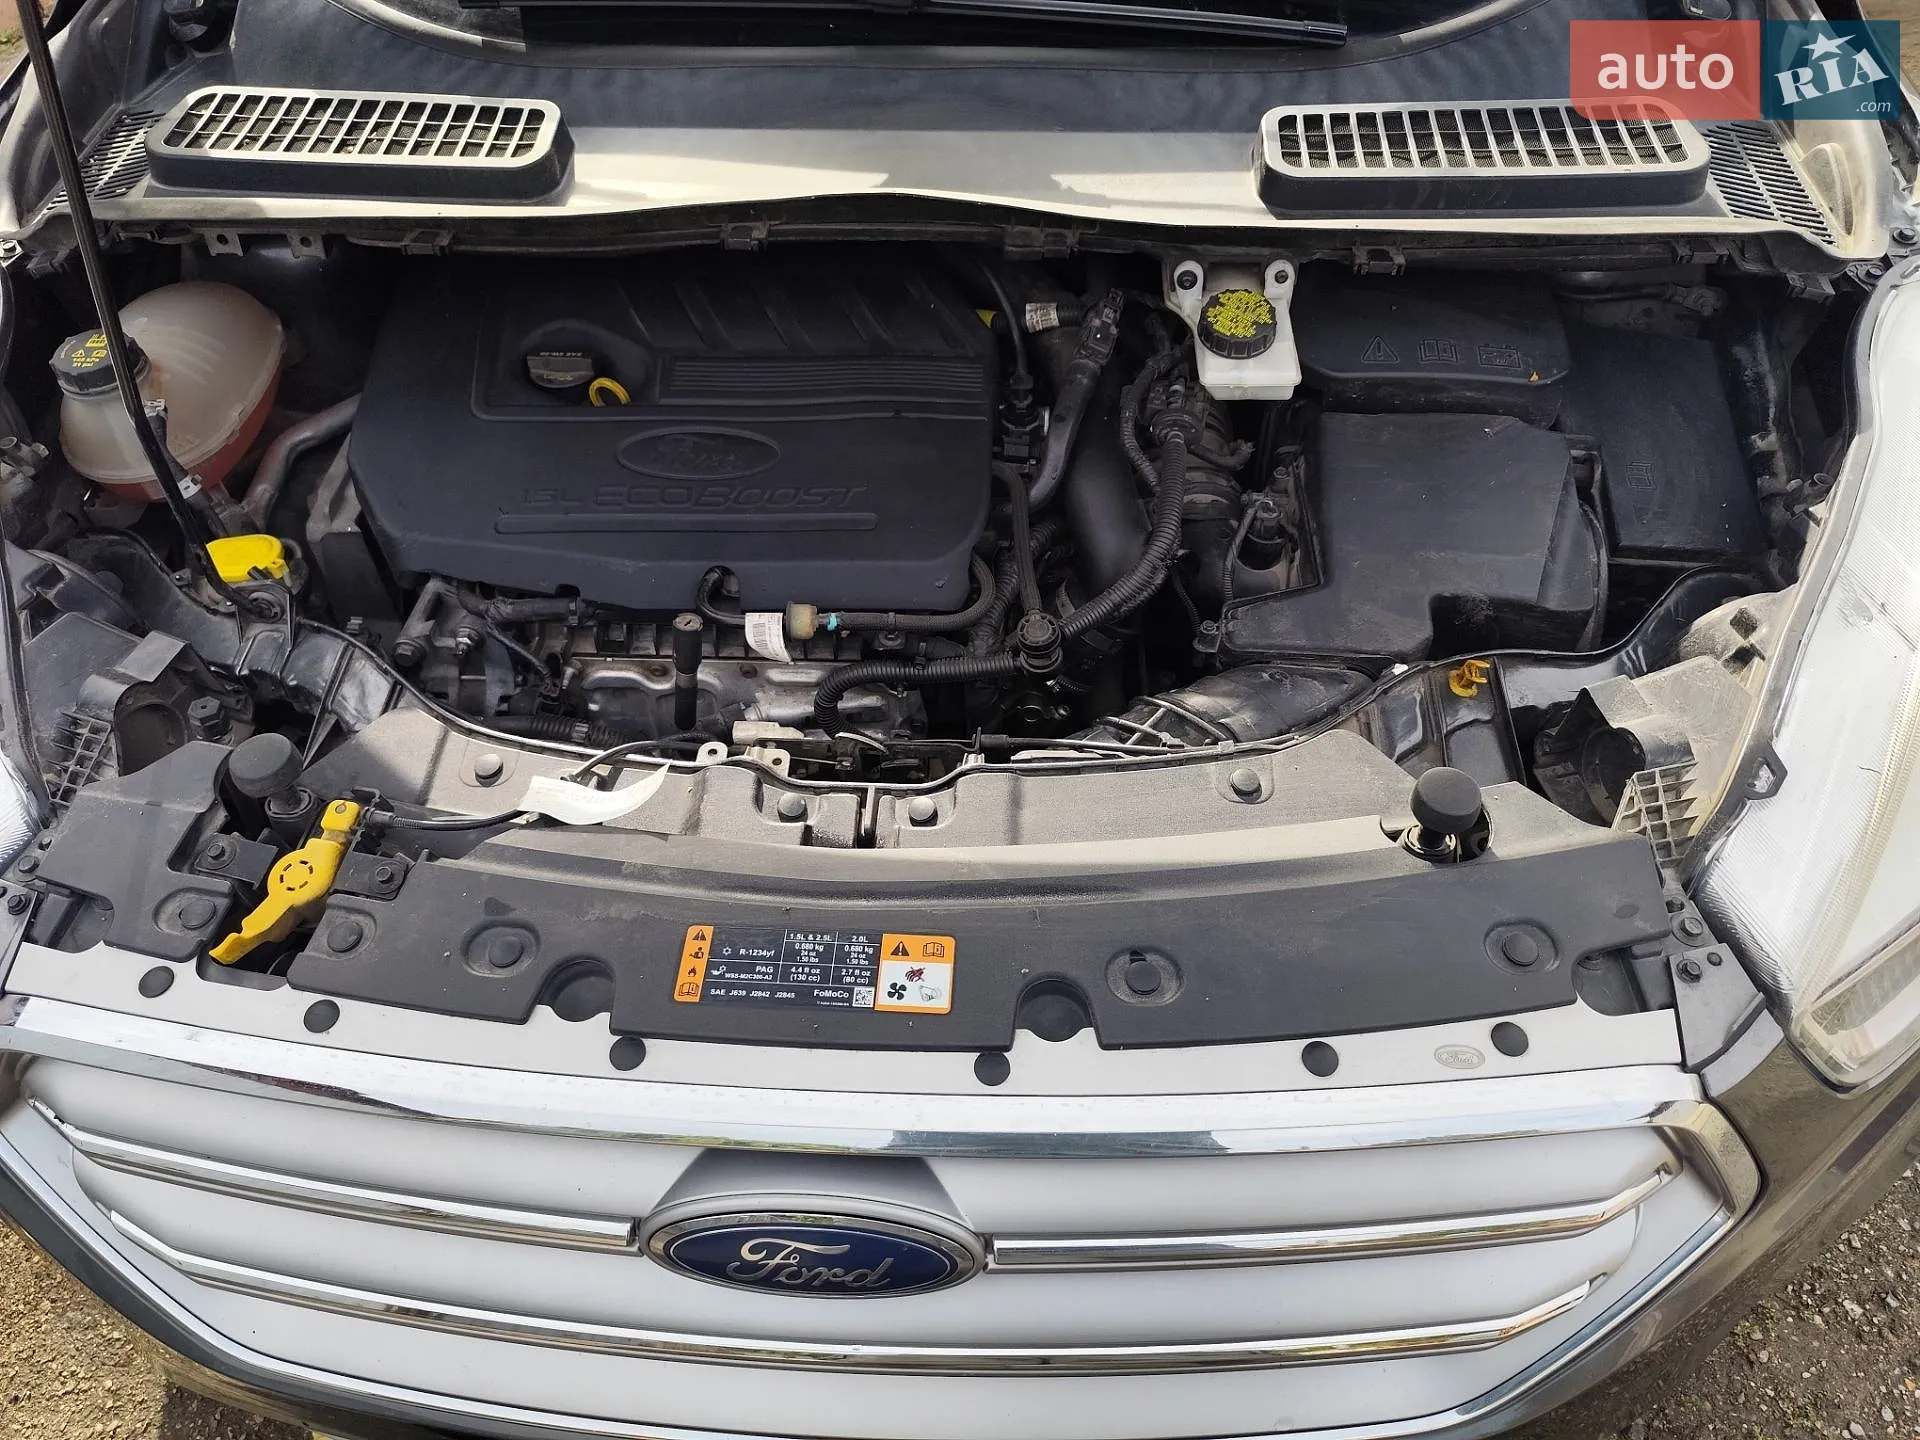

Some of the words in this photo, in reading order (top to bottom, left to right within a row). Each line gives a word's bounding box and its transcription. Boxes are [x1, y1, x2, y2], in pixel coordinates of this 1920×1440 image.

[790, 933, 806, 941] 1.5L
[815, 934, 833, 942] 2.5L
[851, 935, 869, 943] 2.0L
[794, 943, 814, 951] 0.680
[815, 944, 824, 953] kg
[844, 945, 863, 953] 0.680
[864, 946, 874, 954] kg
[739, 948, 775, 958] R-1234yf
[755, 965, 774, 973] PAG
[790, 966, 803, 974] 4.4
[841, 968, 853, 976] 2.7
[790, 973, 807, 982] (130
[808, 974, 821, 983] cc)
[842, 975, 855, 984] (80
[856, 976, 869, 985] cc)
[729, 989, 747, 997] J639
[774, 991, 796, 999] J2845
[813, 989, 850, 998] FoMoCo
[725, 1237, 895, 1288] Ford
